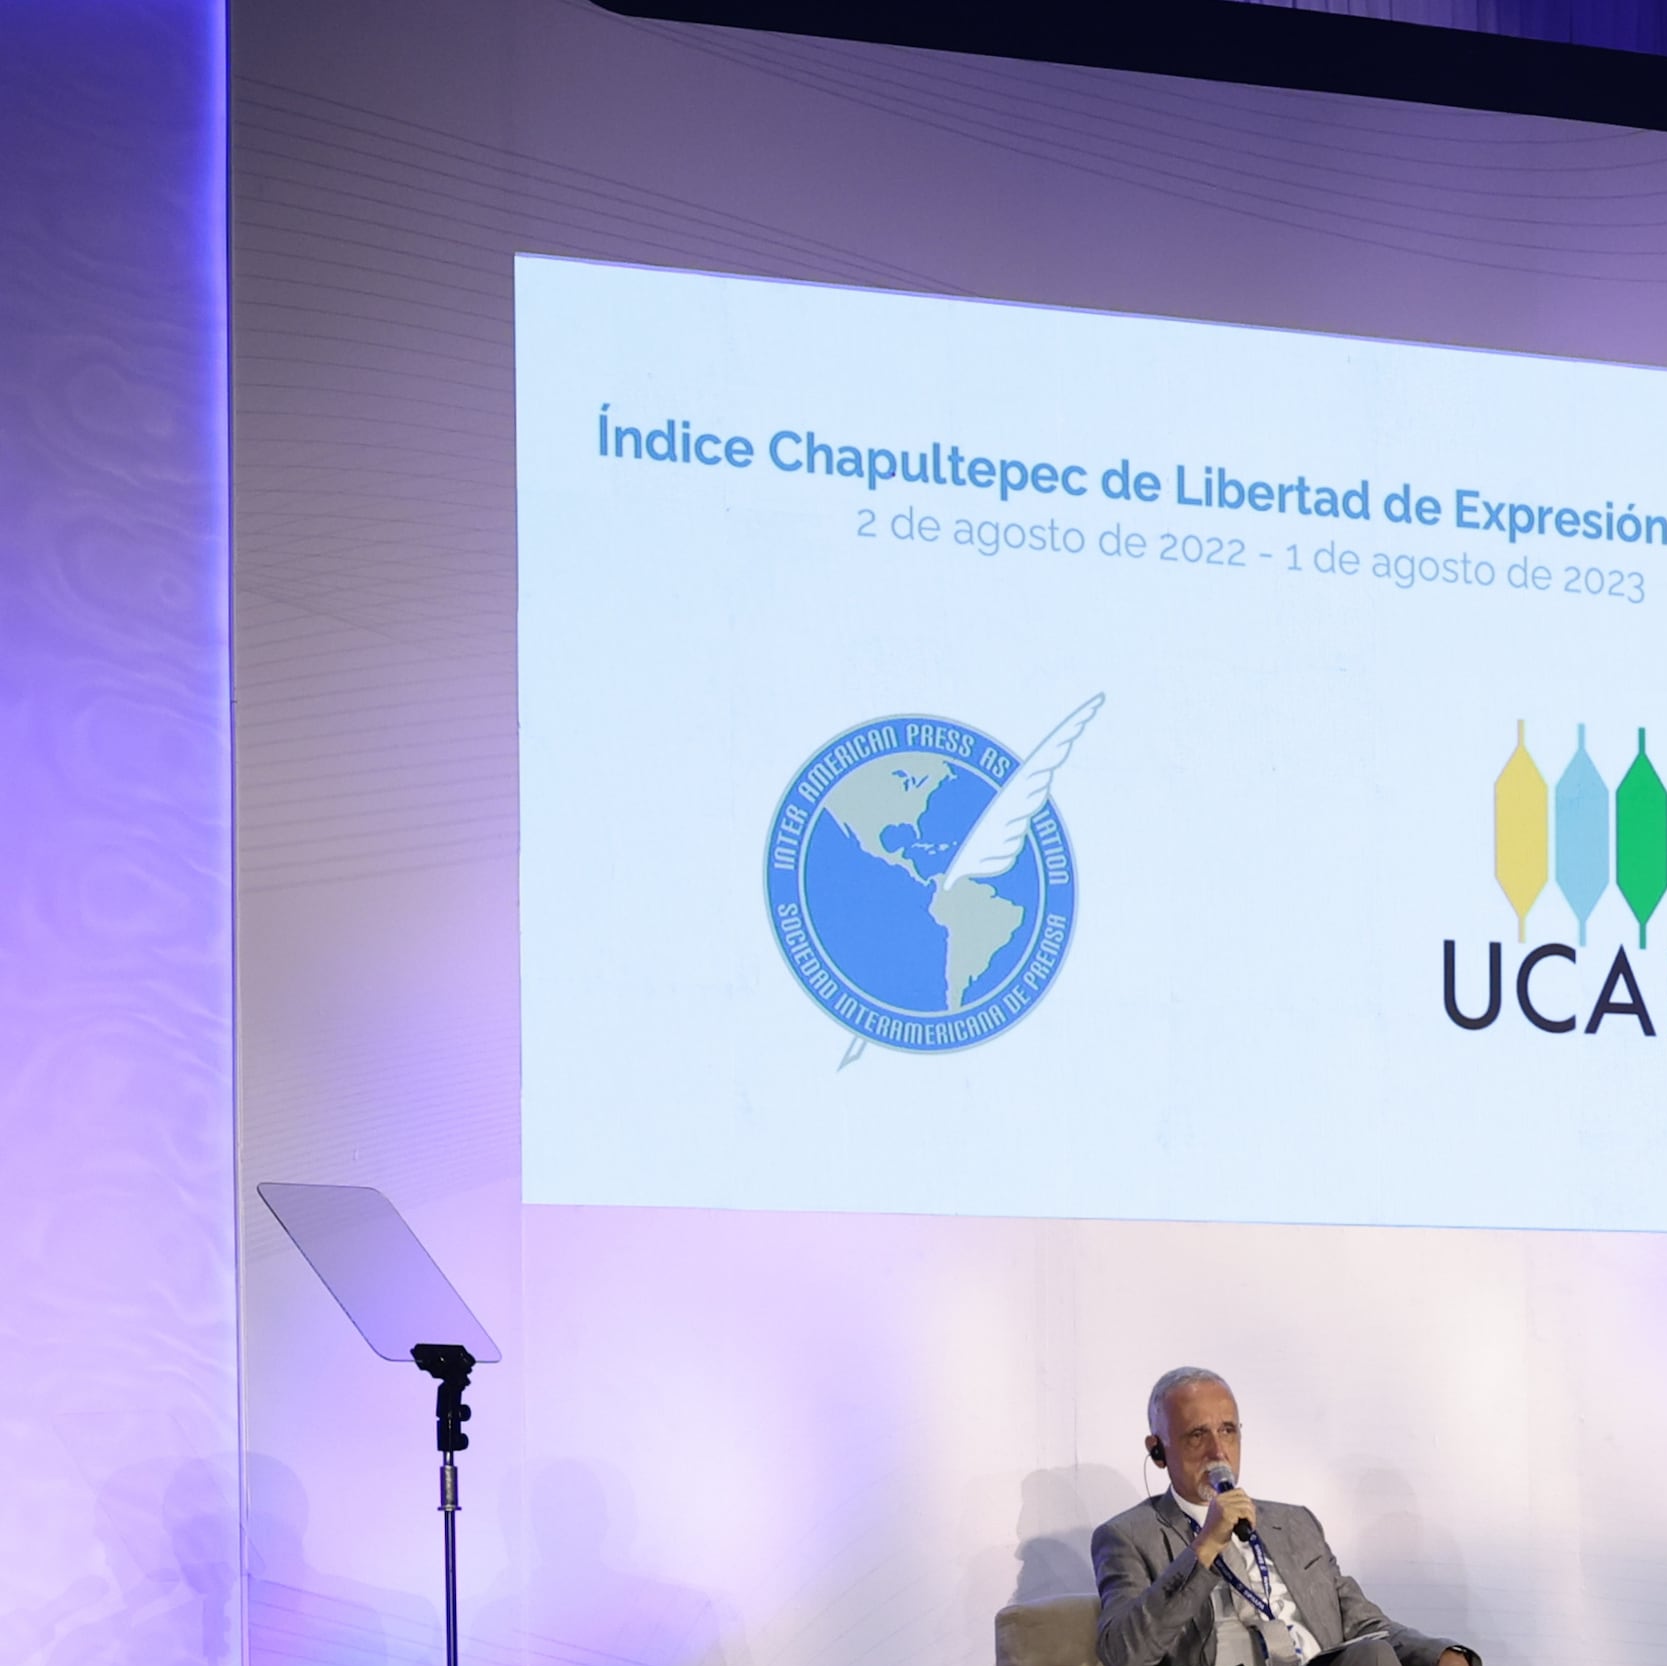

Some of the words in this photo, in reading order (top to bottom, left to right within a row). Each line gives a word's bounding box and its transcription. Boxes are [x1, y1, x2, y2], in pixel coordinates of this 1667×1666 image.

[599, 403, 754, 468] Índice
[769, 431, 1088, 501] Chapultepec
[1101, 459, 1161, 501] de
[1176, 464, 1371, 521] Libertad
[1384, 483, 1441, 526] de
[857, 508, 877, 537] 2
[890, 506, 941, 542] de
[953, 518, 1085, 557] agosto
[1098, 523, 1147, 558] de
[1159, 531, 1246, 567] 2022
[1286, 543, 1303, 571] 1
[1313, 540, 1361, 575] de
[1371, 550, 1496, 589] agosto
[1507, 555, 1553, 590] de
[1563, 566, 1646, 604] 2023
[773, 803, 809, 871] INTER
[798, 726, 898, 804] AMERICAN
[906, 723, 976, 758] PRESS
[777, 902, 838, 999] SOCIEDAD
[834, 992, 1008, 1046] INTERAMERICANA
[1001, 983, 1032, 1015] DE
[1022, 914, 1067, 997] PRENSA
